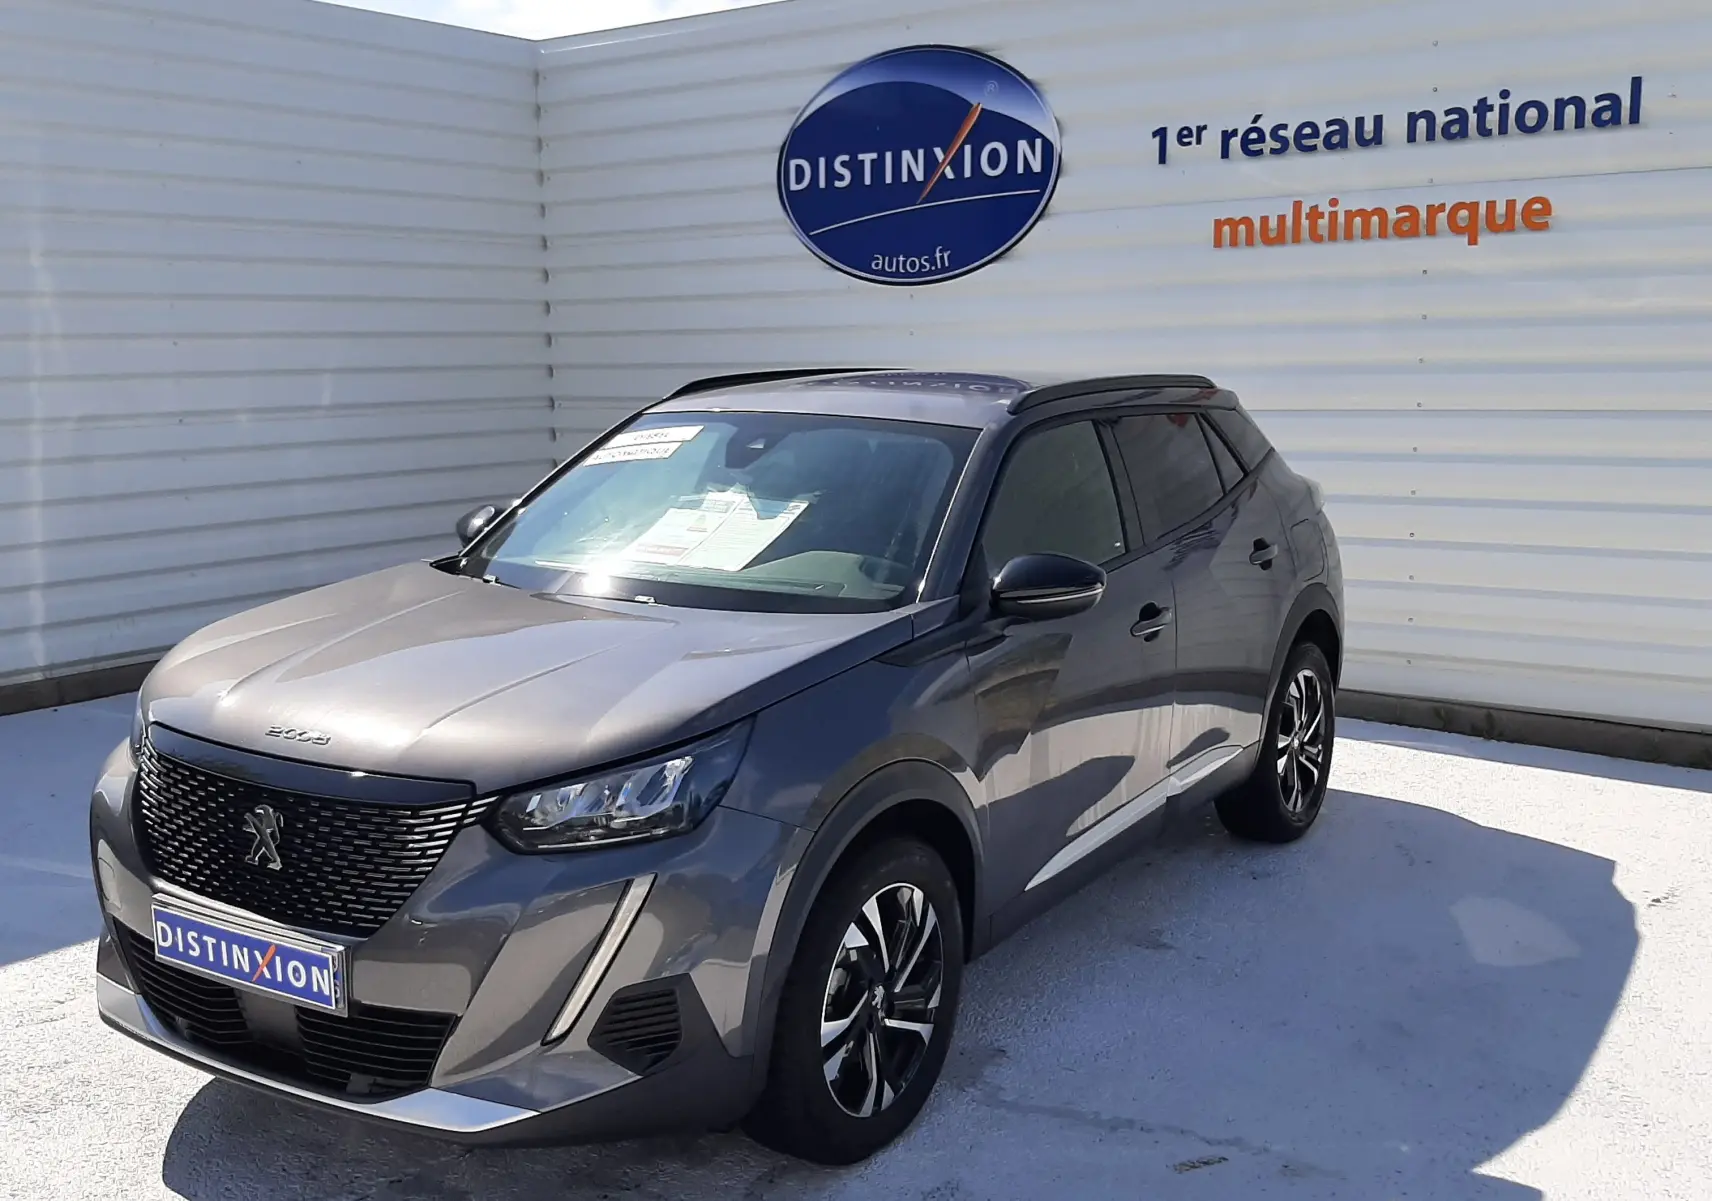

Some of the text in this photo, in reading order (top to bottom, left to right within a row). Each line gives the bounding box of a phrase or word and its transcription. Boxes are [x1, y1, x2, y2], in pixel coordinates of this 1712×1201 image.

[1150, 76, 1643, 165] 1er réseau national
[788, 138, 1043, 192] DISTINXION
[1212, 195, 1553, 248] multimarque
[870, 245, 952, 274] autos.fr
[156, 920, 331, 996] DISTINXION
